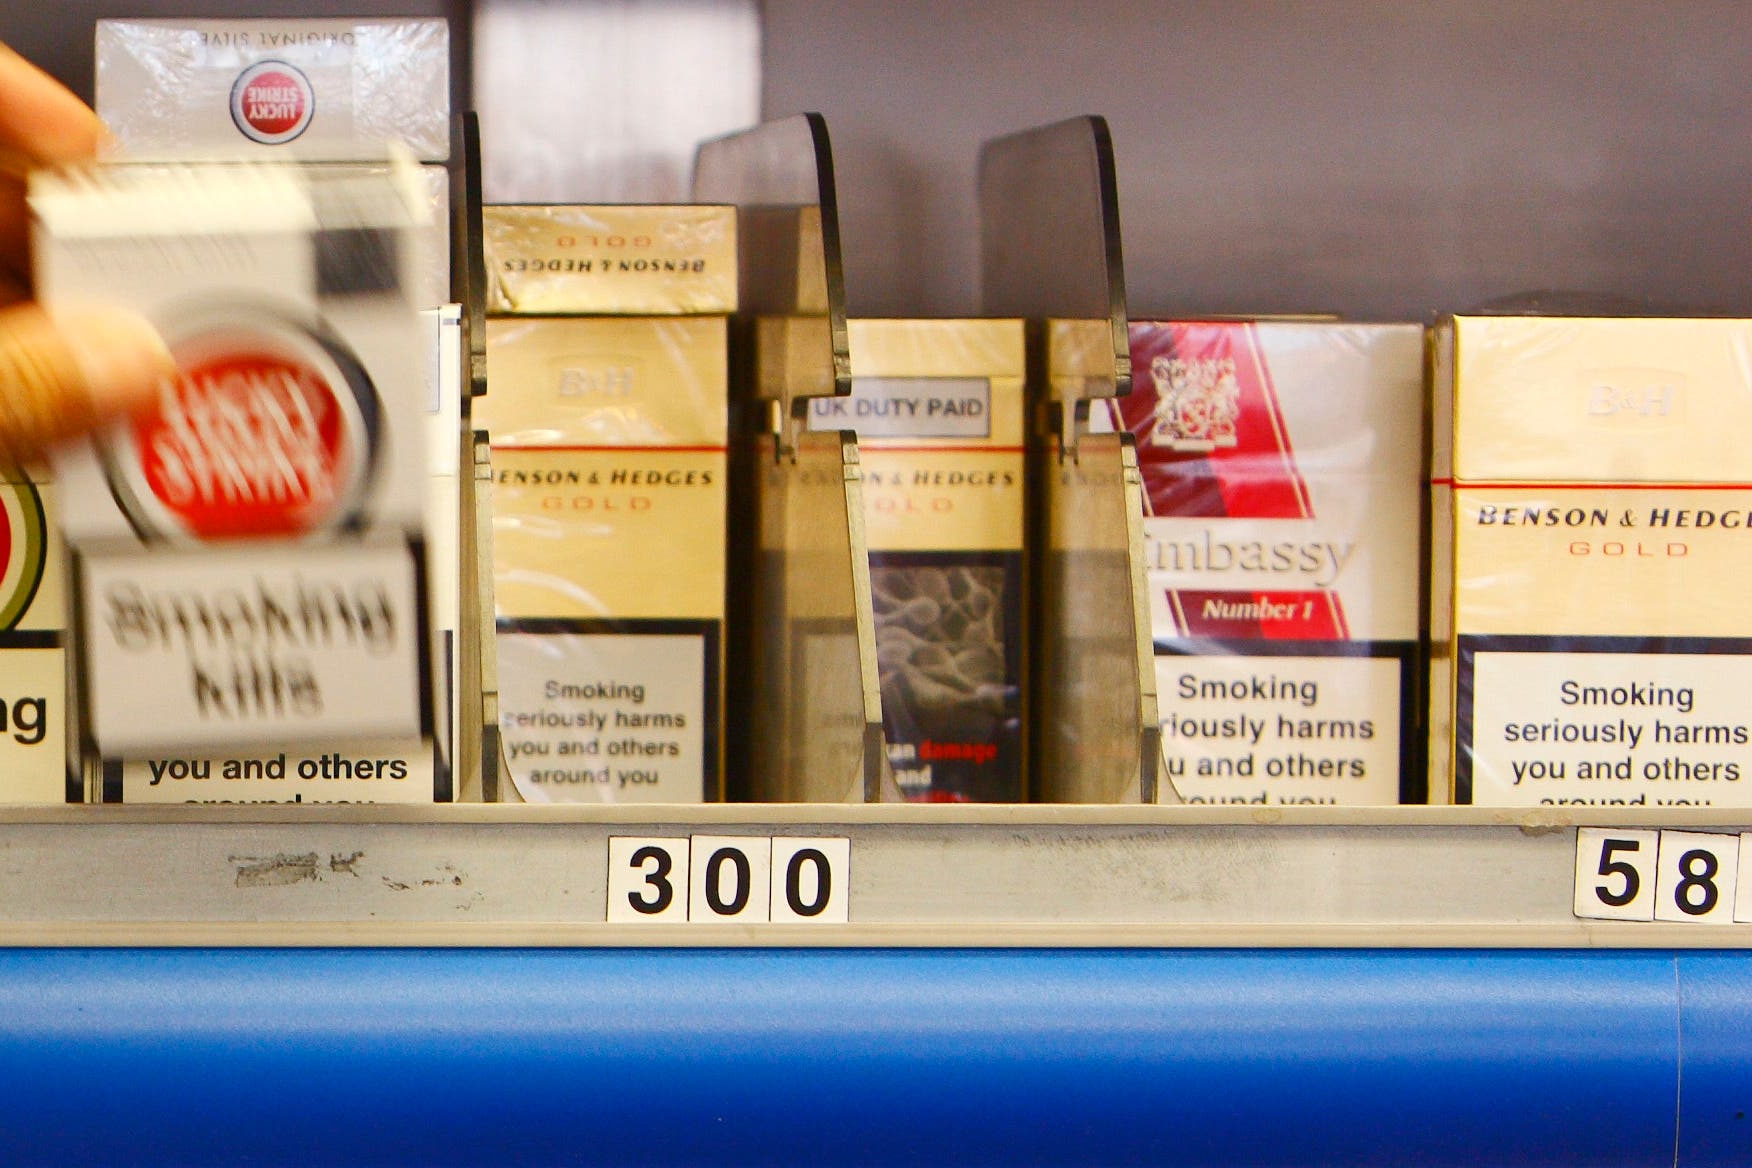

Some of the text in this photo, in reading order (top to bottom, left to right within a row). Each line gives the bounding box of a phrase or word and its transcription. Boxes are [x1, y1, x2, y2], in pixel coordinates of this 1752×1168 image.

[248, 86, 298, 102] STRIKE
[249, 103, 296, 119] LUCKY
[504, 260, 704, 272] BENSON HEDGES
[814, 399, 983, 417] UK DUTY PAID
[499, 470, 712, 485] ENSON HEDGES
[914, 470, 1013, 485] HEDGES
[1478, 505, 1752, 528] BENSON & HEDG
[1569, 542, 1689, 557] GOLD
[1202, 598, 1312, 621] Number 1
[545, 680, 644, 702] Smoking
[1178, 675, 1318, 706] Smoking
[1560, 681, 1694, 712] Smoking
[615, 710, 686, 728] harms
[1278, 715, 1374, 739] harms
[1504, 719, 1748, 749] seriously harms
[509, 739, 680, 759] you and others
[149, 754, 408, 785] you and others
[1198, 753, 1253, 777] and
[1266, 753, 1365, 777] others
[1511, 757, 1740, 785] you and others
[530, 767, 659, 787] around you
[627, 847, 834, 917] 300
[1595, 839, 1718, 916] 58
